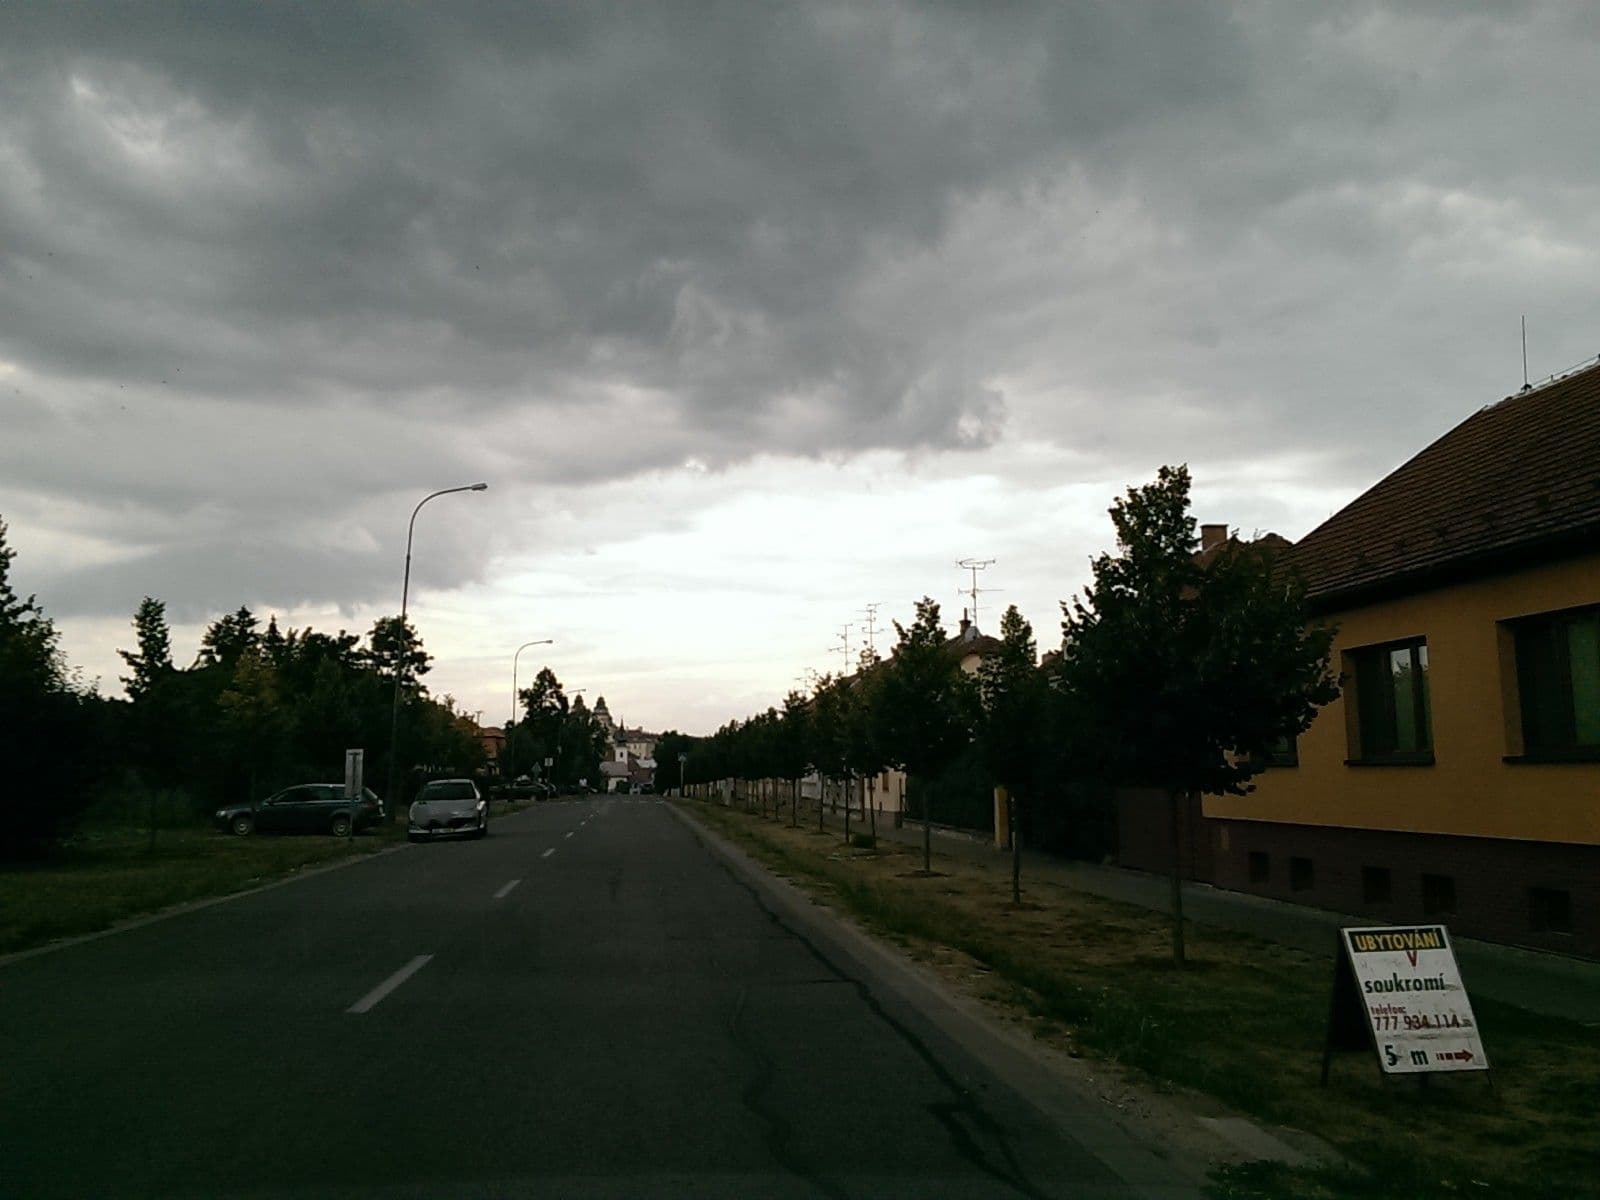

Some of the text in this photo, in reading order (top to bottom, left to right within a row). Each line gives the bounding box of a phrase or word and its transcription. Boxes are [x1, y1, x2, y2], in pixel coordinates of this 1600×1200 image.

[1354, 930, 1441, 951] UBYTOVÁNÍ
[1364, 972, 1446, 994] soukromí
[1373, 1016, 1399, 1031] 777
[1434, 1014, 1460, 1029] 114
[1384, 1045, 1429, 1067] 5 m
